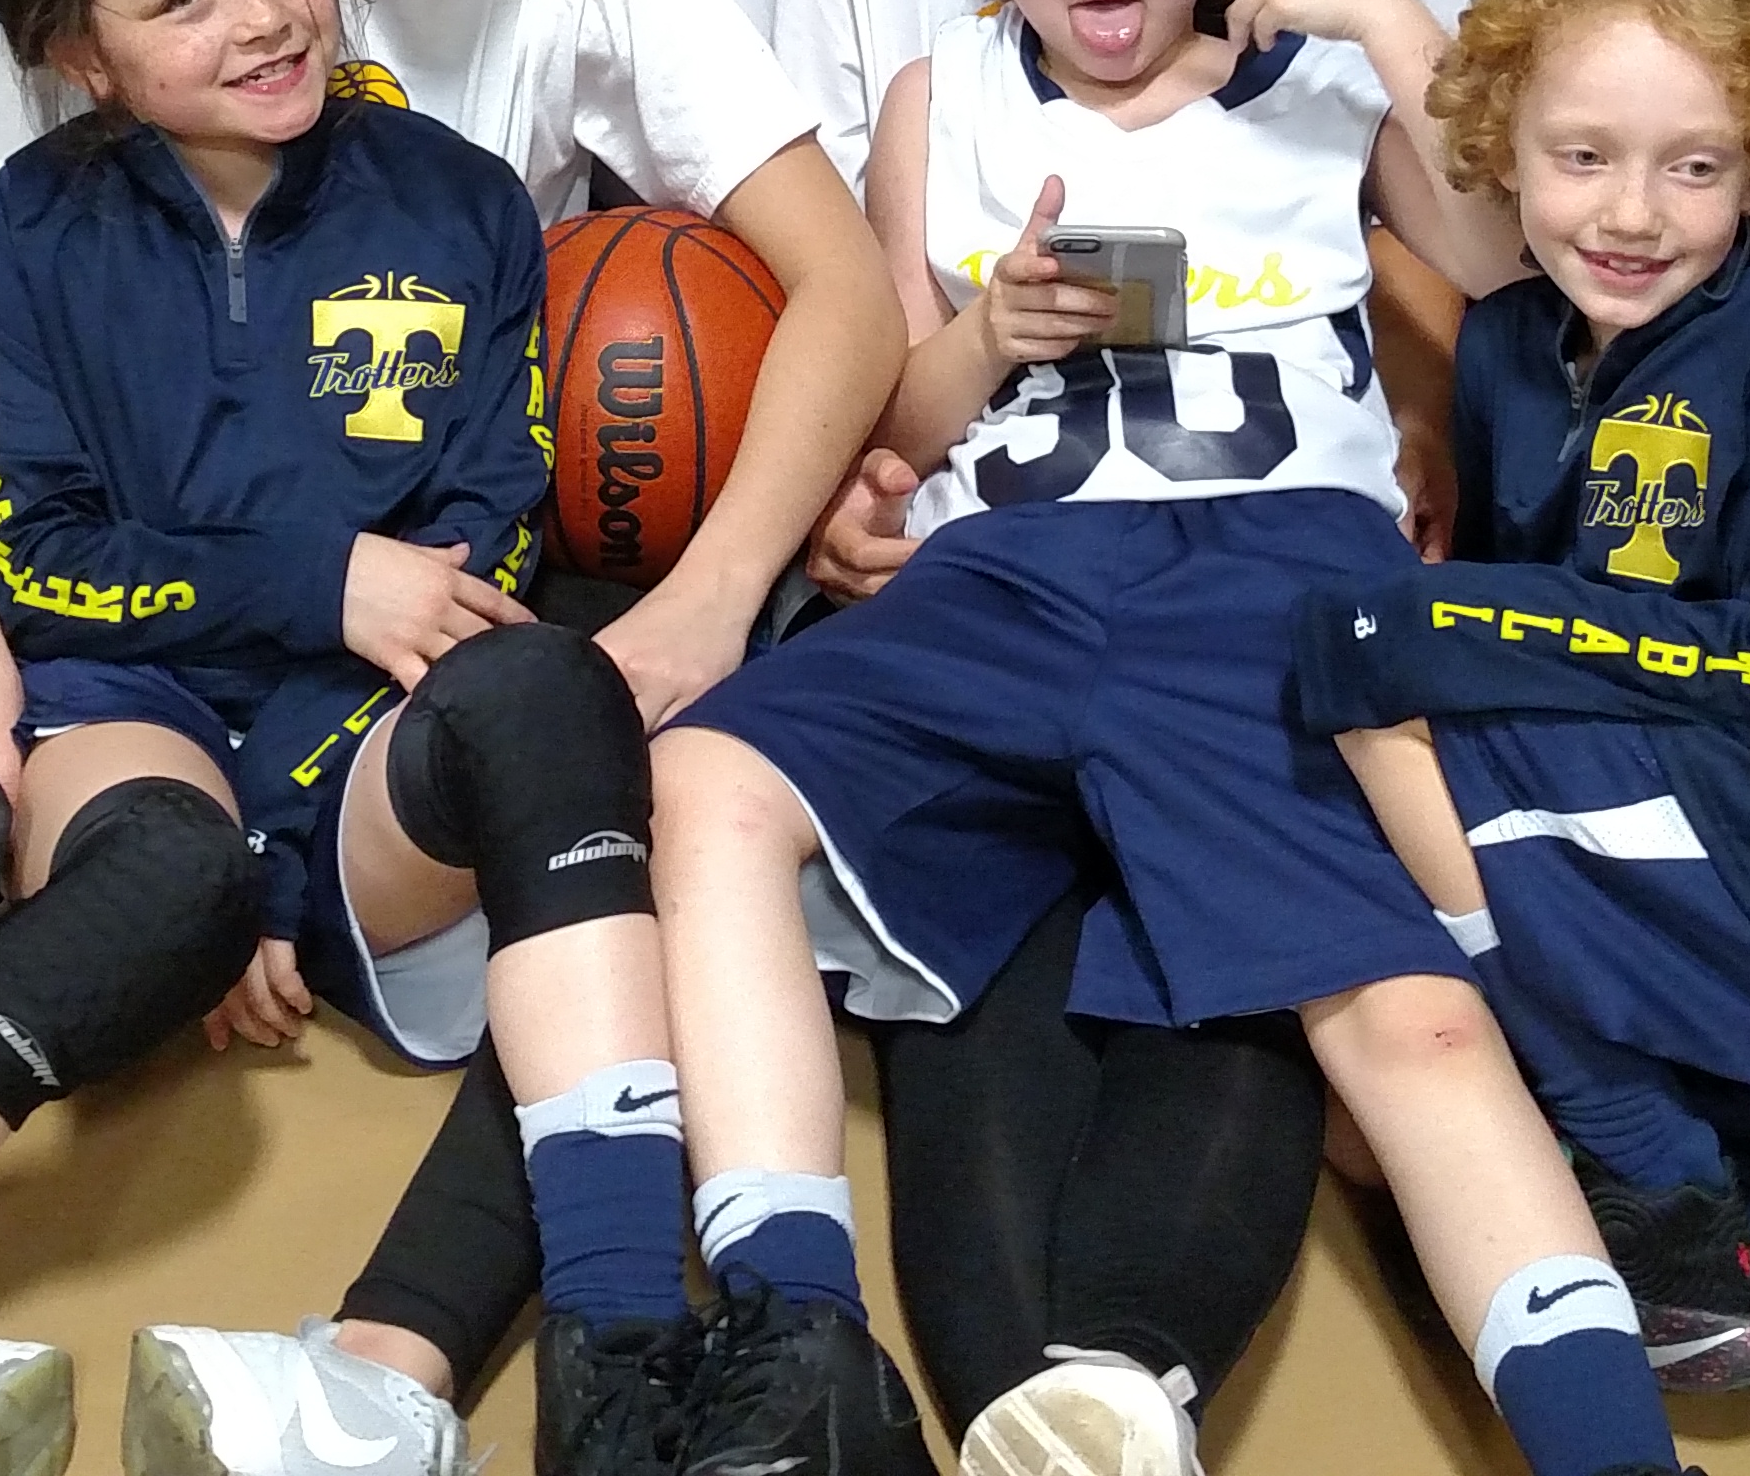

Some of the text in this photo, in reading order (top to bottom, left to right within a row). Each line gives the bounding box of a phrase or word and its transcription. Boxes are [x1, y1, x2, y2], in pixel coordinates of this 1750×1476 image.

[307, 350, 460, 398] Trotters
[596, 334, 664, 567] Wilson
[1583, 480, 1708, 528] Trotters
